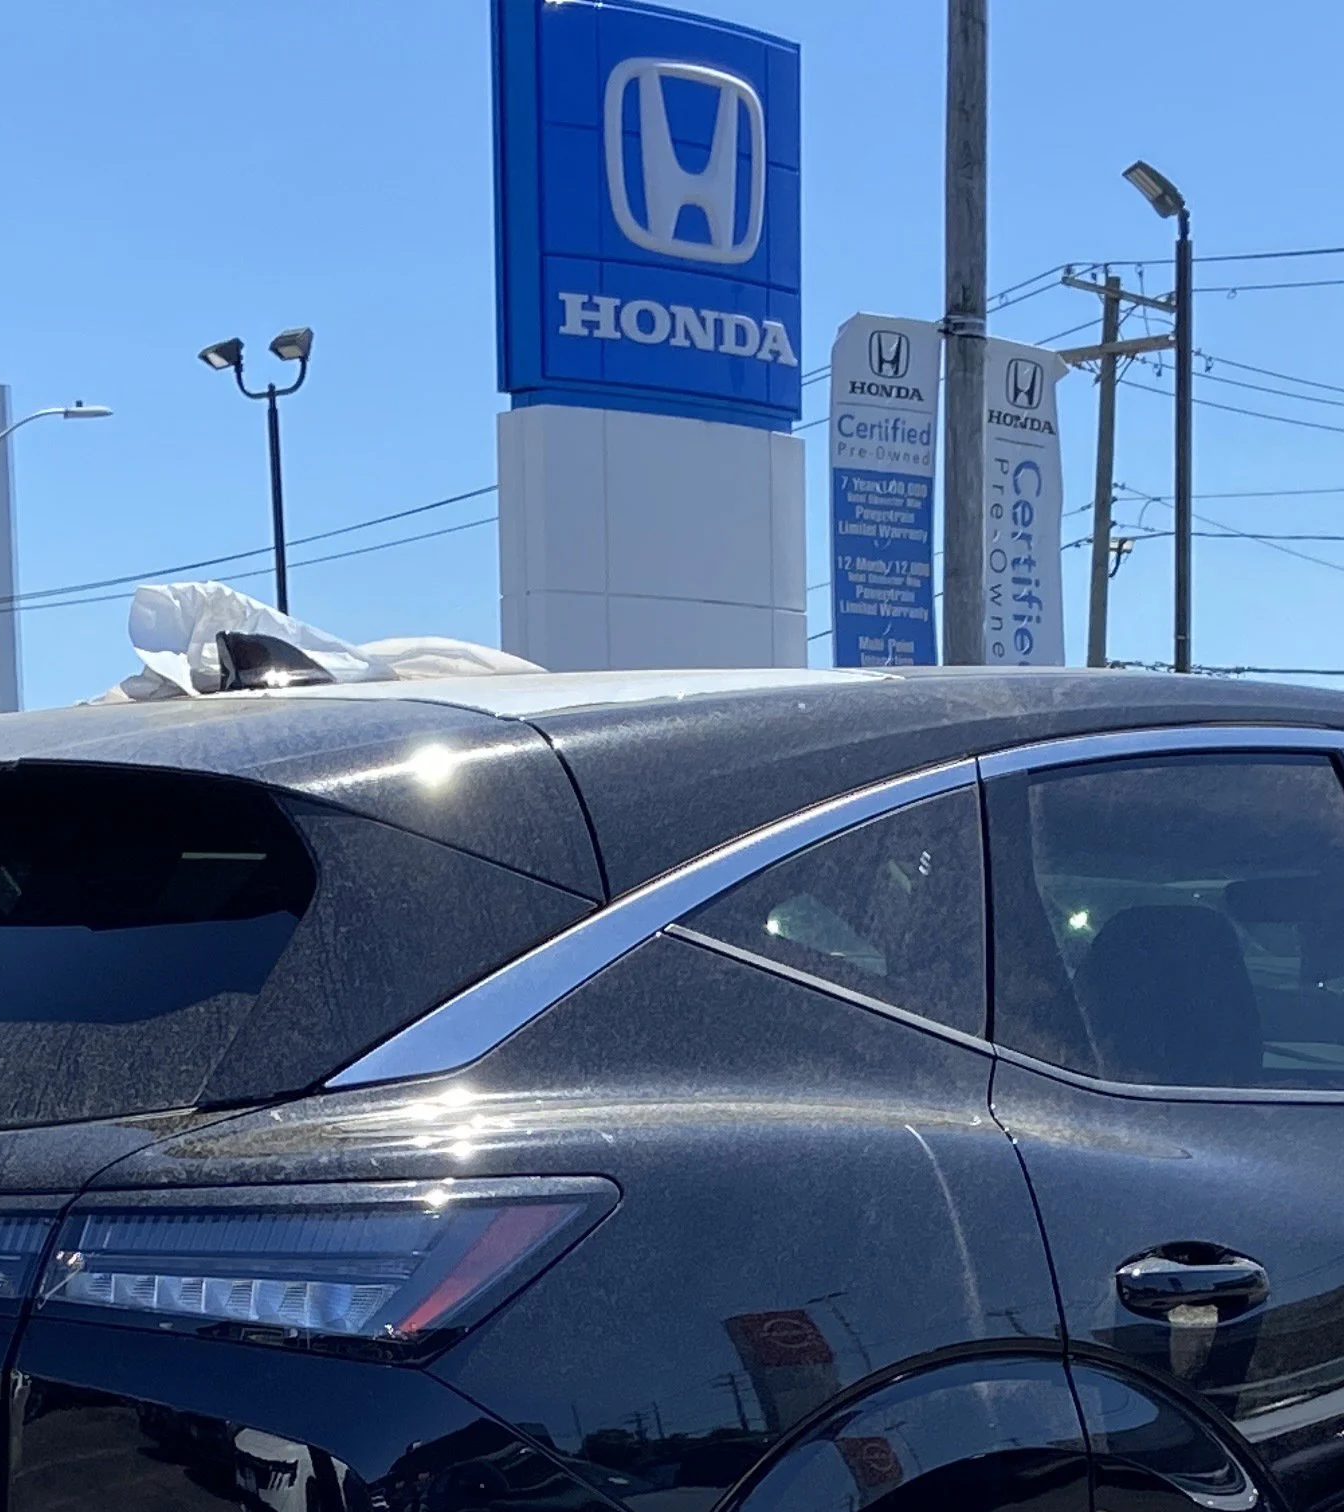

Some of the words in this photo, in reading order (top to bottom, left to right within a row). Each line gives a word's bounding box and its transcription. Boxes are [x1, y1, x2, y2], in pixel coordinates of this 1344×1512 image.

[558, 291, 798, 367] HONDA
[849, 380, 924, 402] HONDA
[837, 413, 931, 446] Certified
[987, 409, 1057, 435] HONDA
[837, 441, 931, 466] Pre-Owned
[989, 457, 1010, 659] Pre-Owne
[1010, 460, 1044, 667] Certifie
